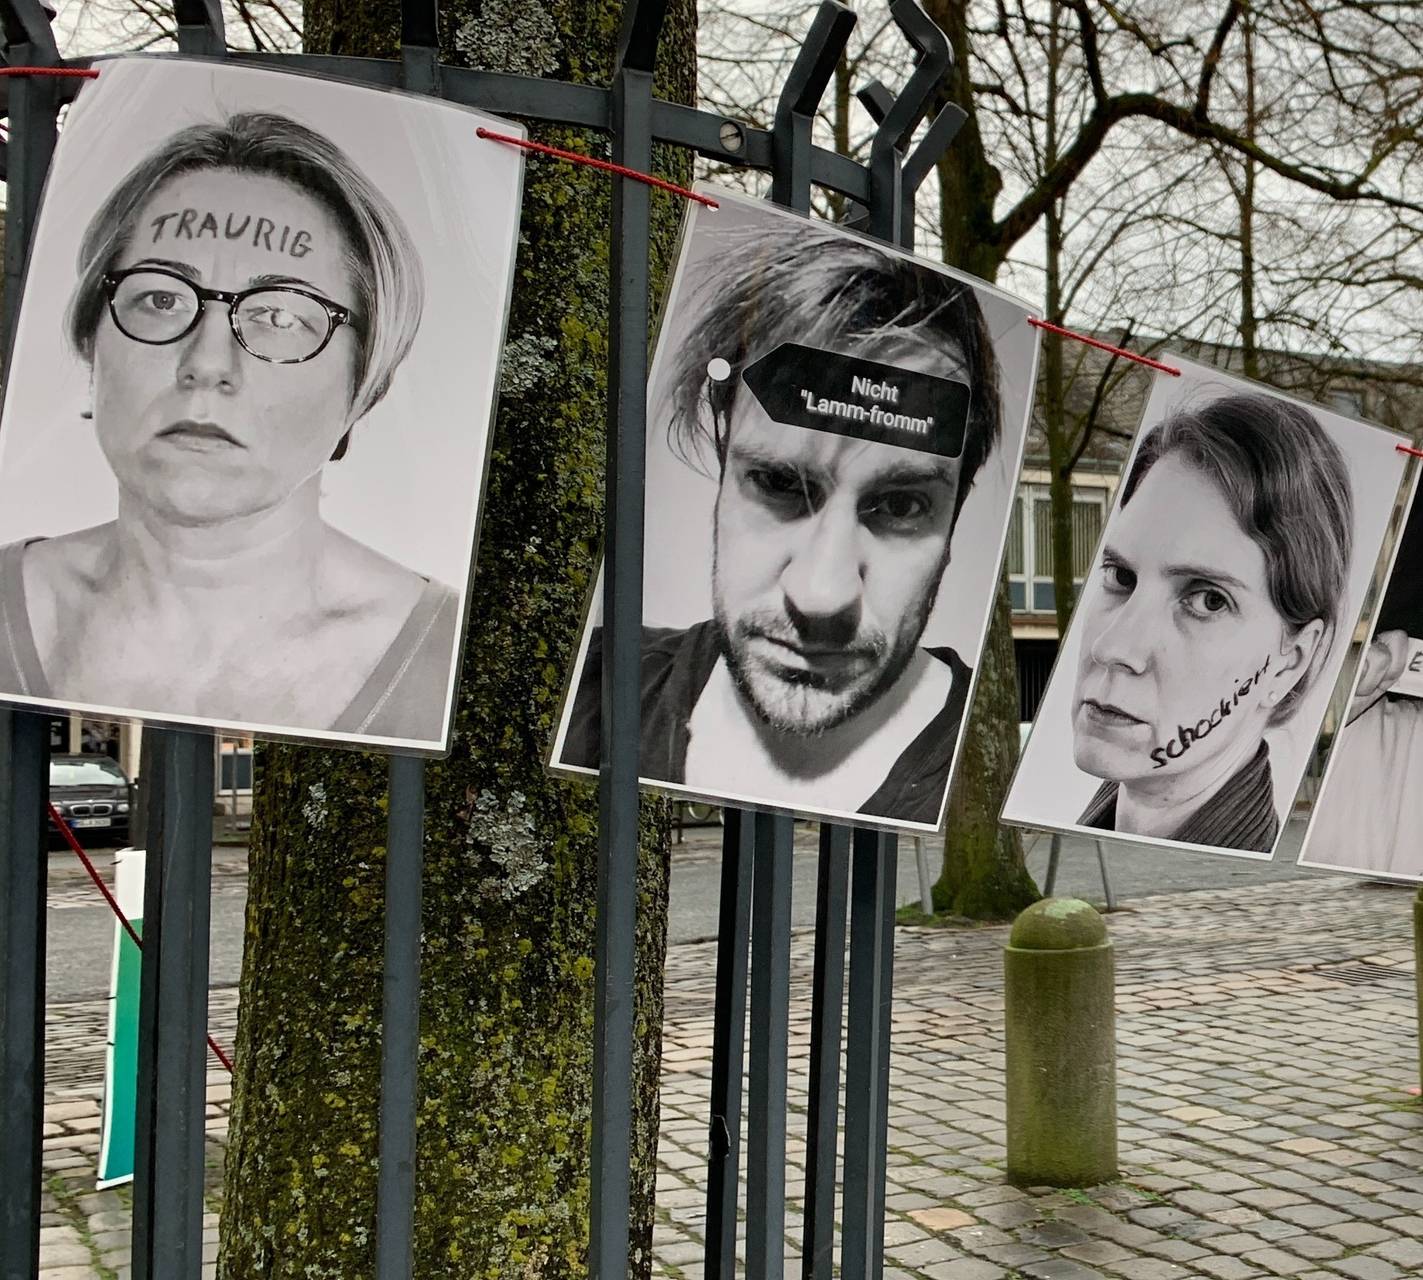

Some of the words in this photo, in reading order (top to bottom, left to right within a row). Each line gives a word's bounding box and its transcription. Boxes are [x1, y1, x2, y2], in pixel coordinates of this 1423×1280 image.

[151, 208, 313, 258] TRAURIG
[800, 388, 934, 434] "Lamm-fromm"
[850, 375, 899, 402] Nicht
[1150, 654, 1271, 769] schockiert
